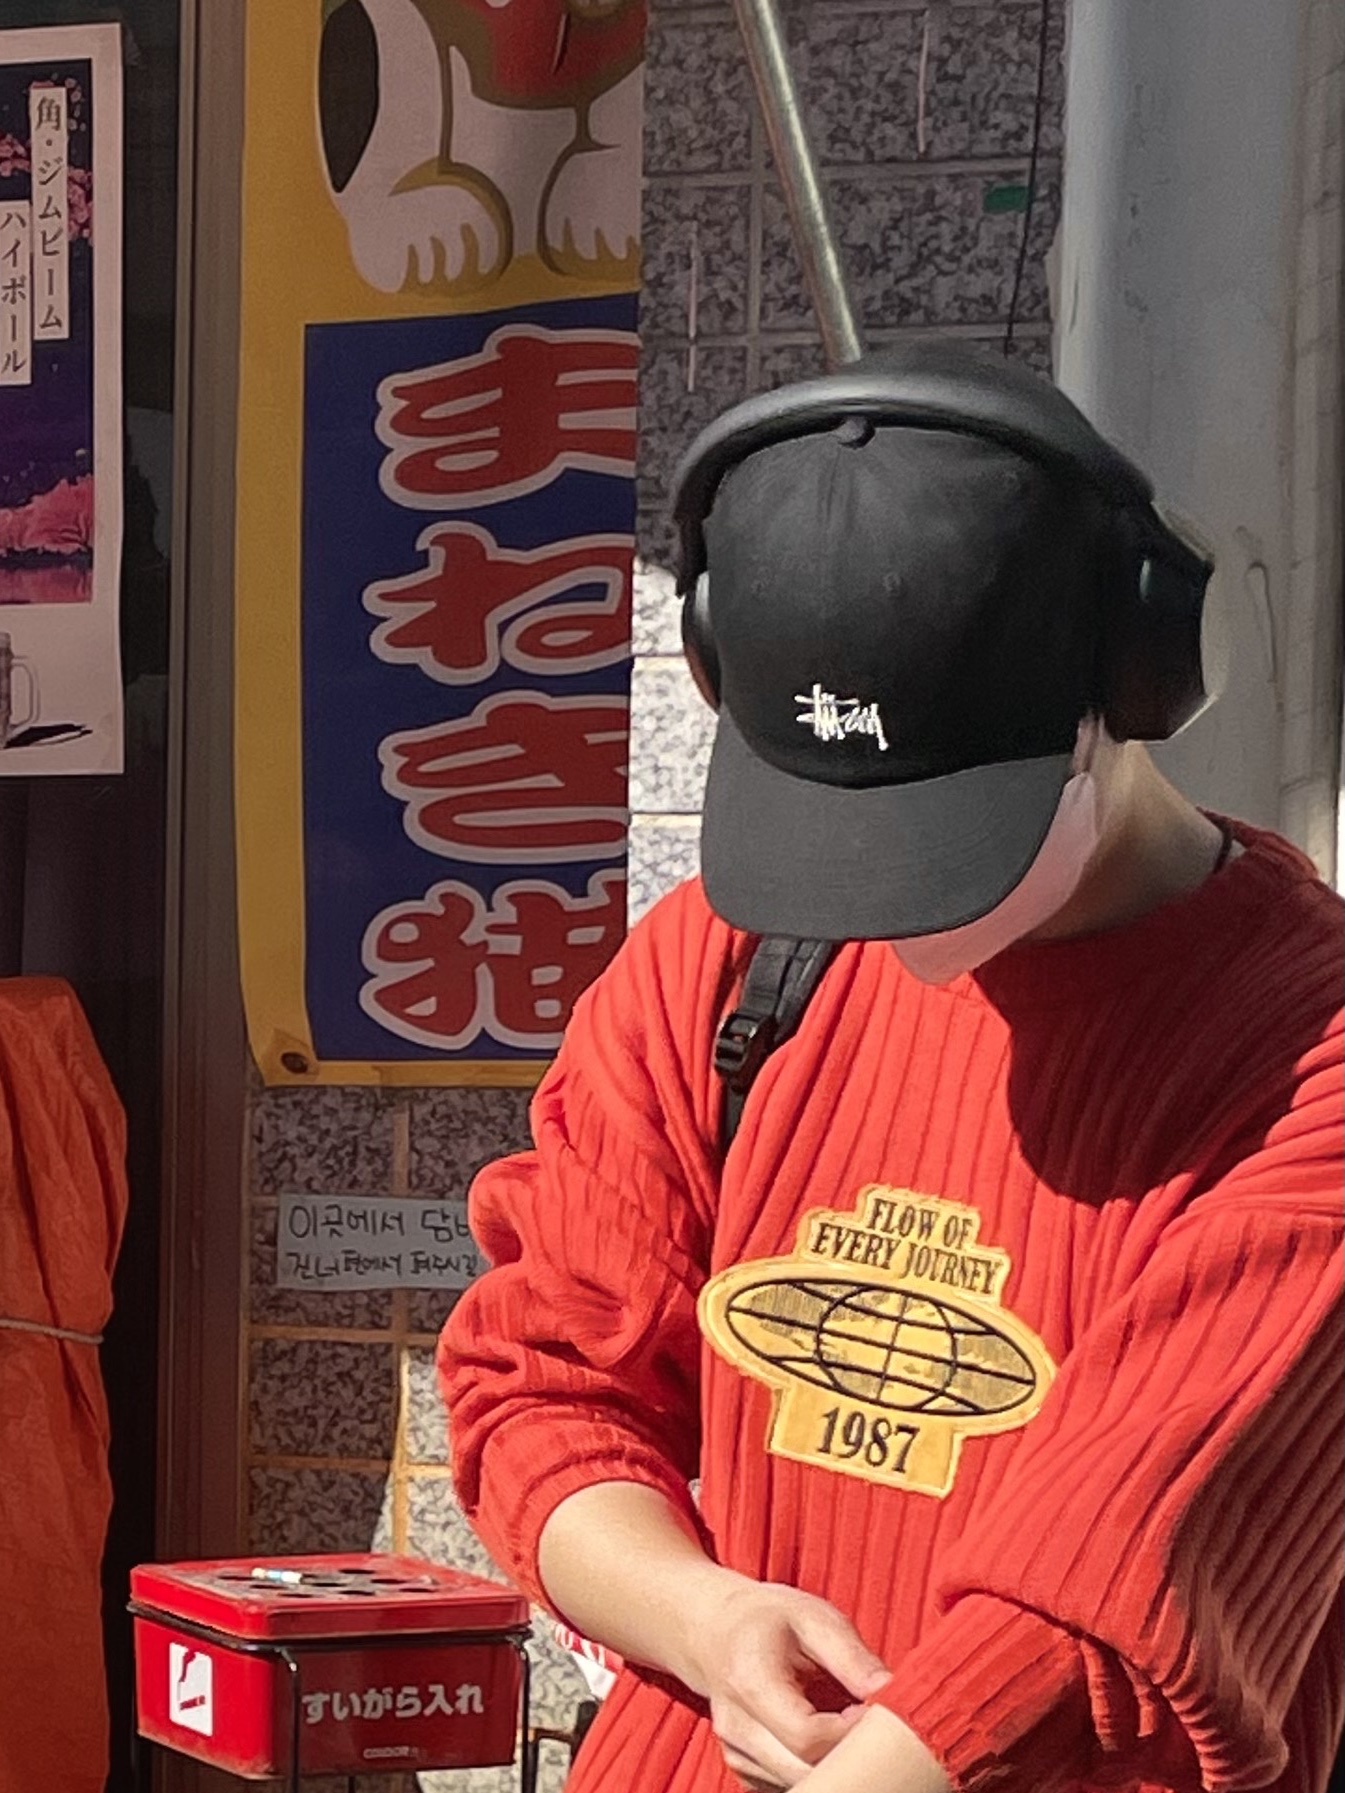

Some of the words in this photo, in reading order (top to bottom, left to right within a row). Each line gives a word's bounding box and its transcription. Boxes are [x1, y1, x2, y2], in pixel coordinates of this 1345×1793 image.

[35, 97, 64, 331] 角・ジムビーム
[0, 209, 28, 374] ハイボール
[288, 1204, 405, 1238] 이곳에서
[867, 1196, 940, 1240] FLOW
[943, 1213, 974, 1248] OF
[810, 1221, 902, 1270] EVERY
[901, 1242, 1003, 1296] JOURNEY
[816, 1406, 920, 1474] 1987
[301, 1682, 485, 1725] すいがら入れ
